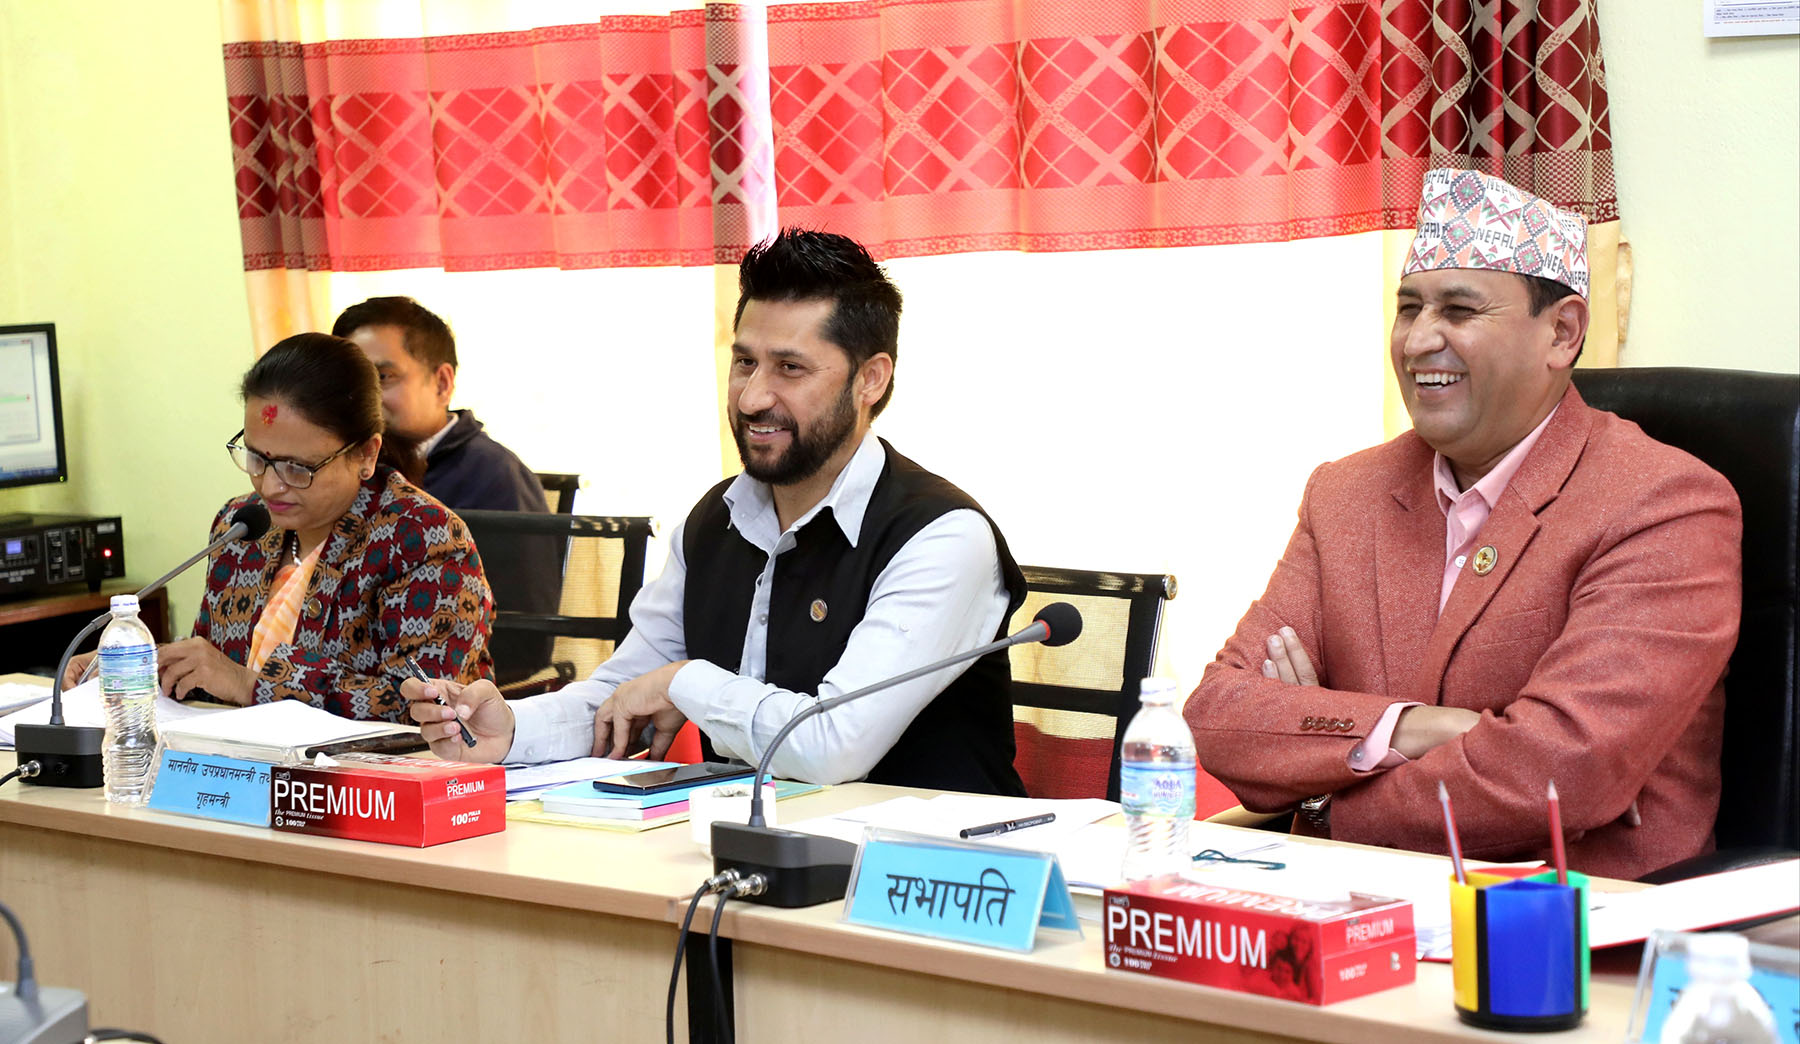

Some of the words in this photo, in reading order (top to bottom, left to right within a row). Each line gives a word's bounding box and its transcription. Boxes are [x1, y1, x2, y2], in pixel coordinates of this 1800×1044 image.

[1487, 177, 1521, 202] NEPAL
[1475, 228, 1515, 250] NEPAL
[168, 758, 199, 775] माननीय
[196, 792, 231, 809] गृहमन्त्री
[274, 779, 395, 821] PREMIUM
[447, 780, 485, 798] PREMIUM
[451, 813, 468, 826] 100
[886, 867, 1016, 926] सभापति
[1108, 904, 1267, 969] PREMIUM
[1345, 918, 1394, 944] PREMIUM
